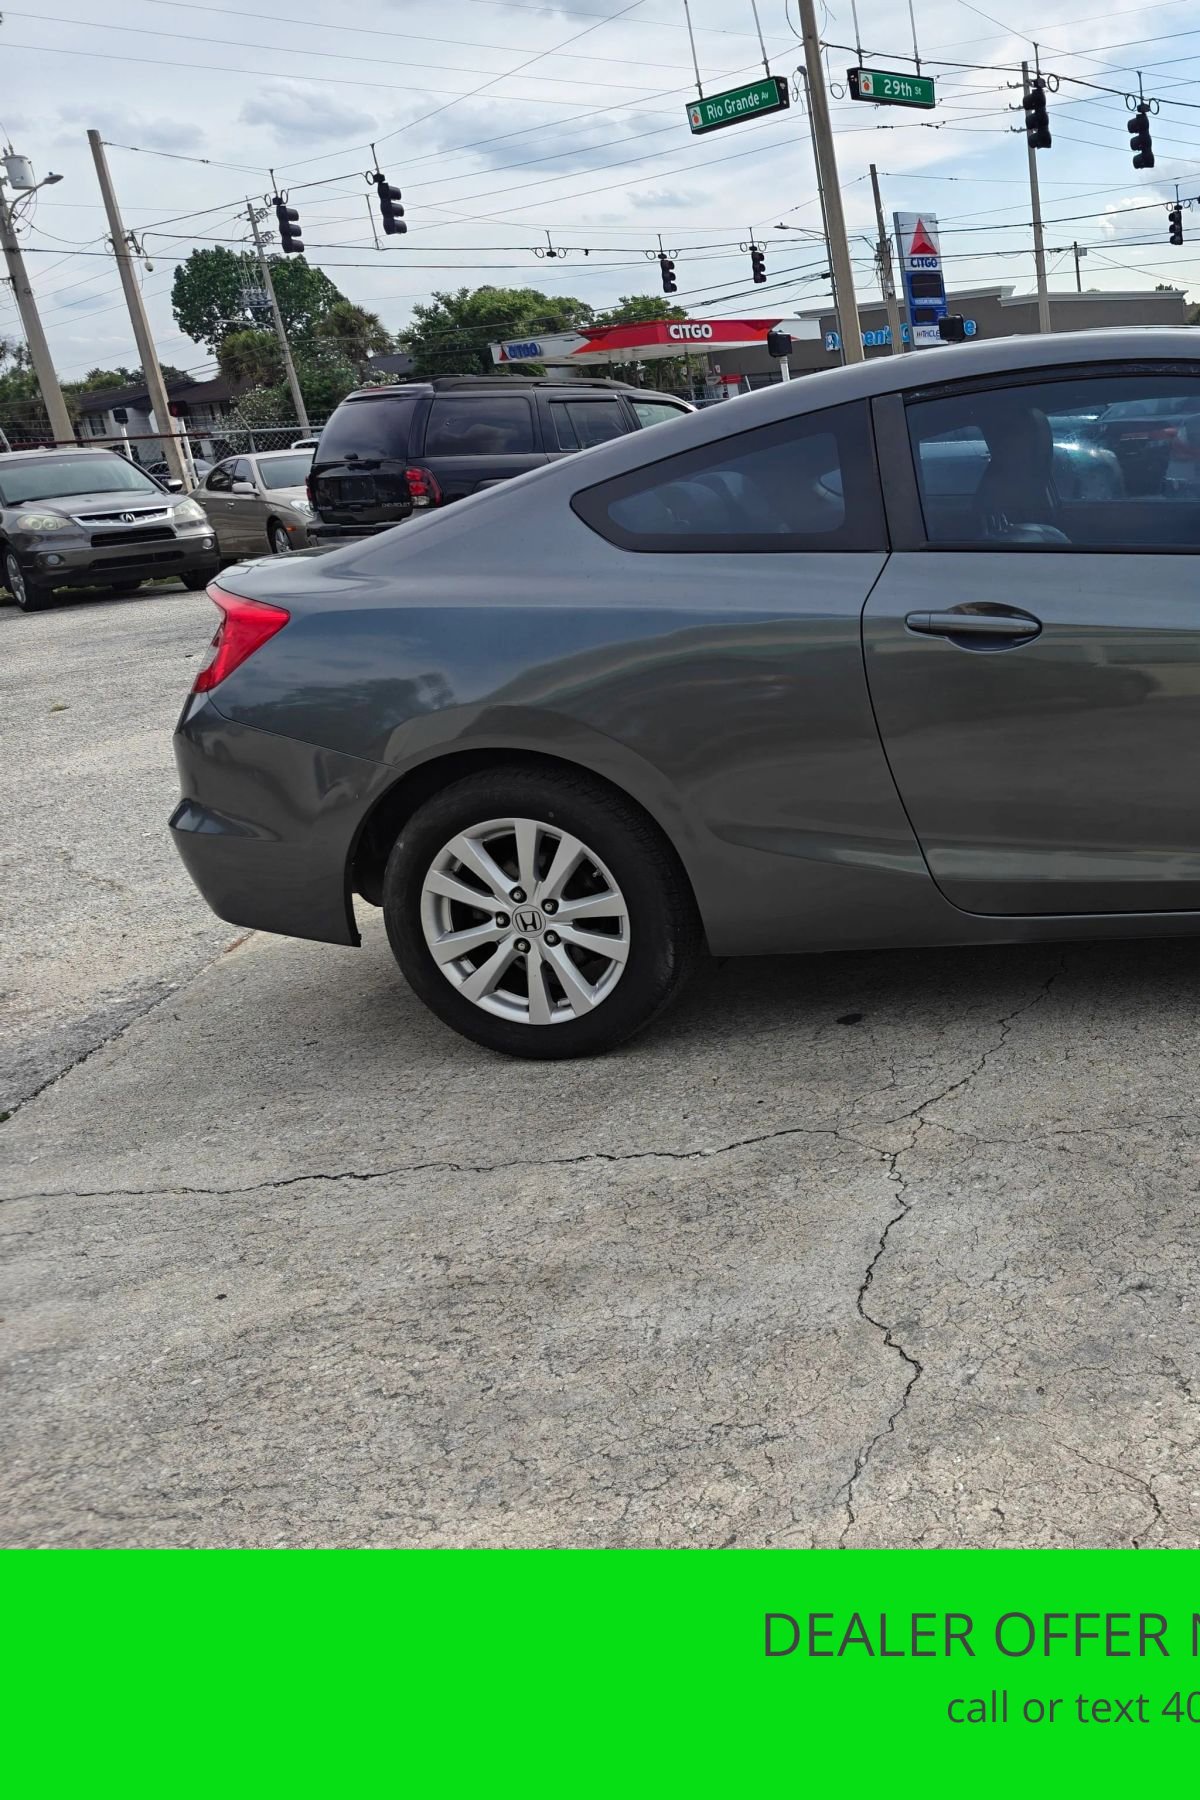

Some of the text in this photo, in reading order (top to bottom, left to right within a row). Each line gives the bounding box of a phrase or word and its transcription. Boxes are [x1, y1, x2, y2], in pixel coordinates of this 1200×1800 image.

[883, 78, 922, 97] 29th St
[706, 91, 770, 120] Rio Grande Av
[911, 257, 938, 268] CITGO
[669, 324, 713, 340] CITGO
